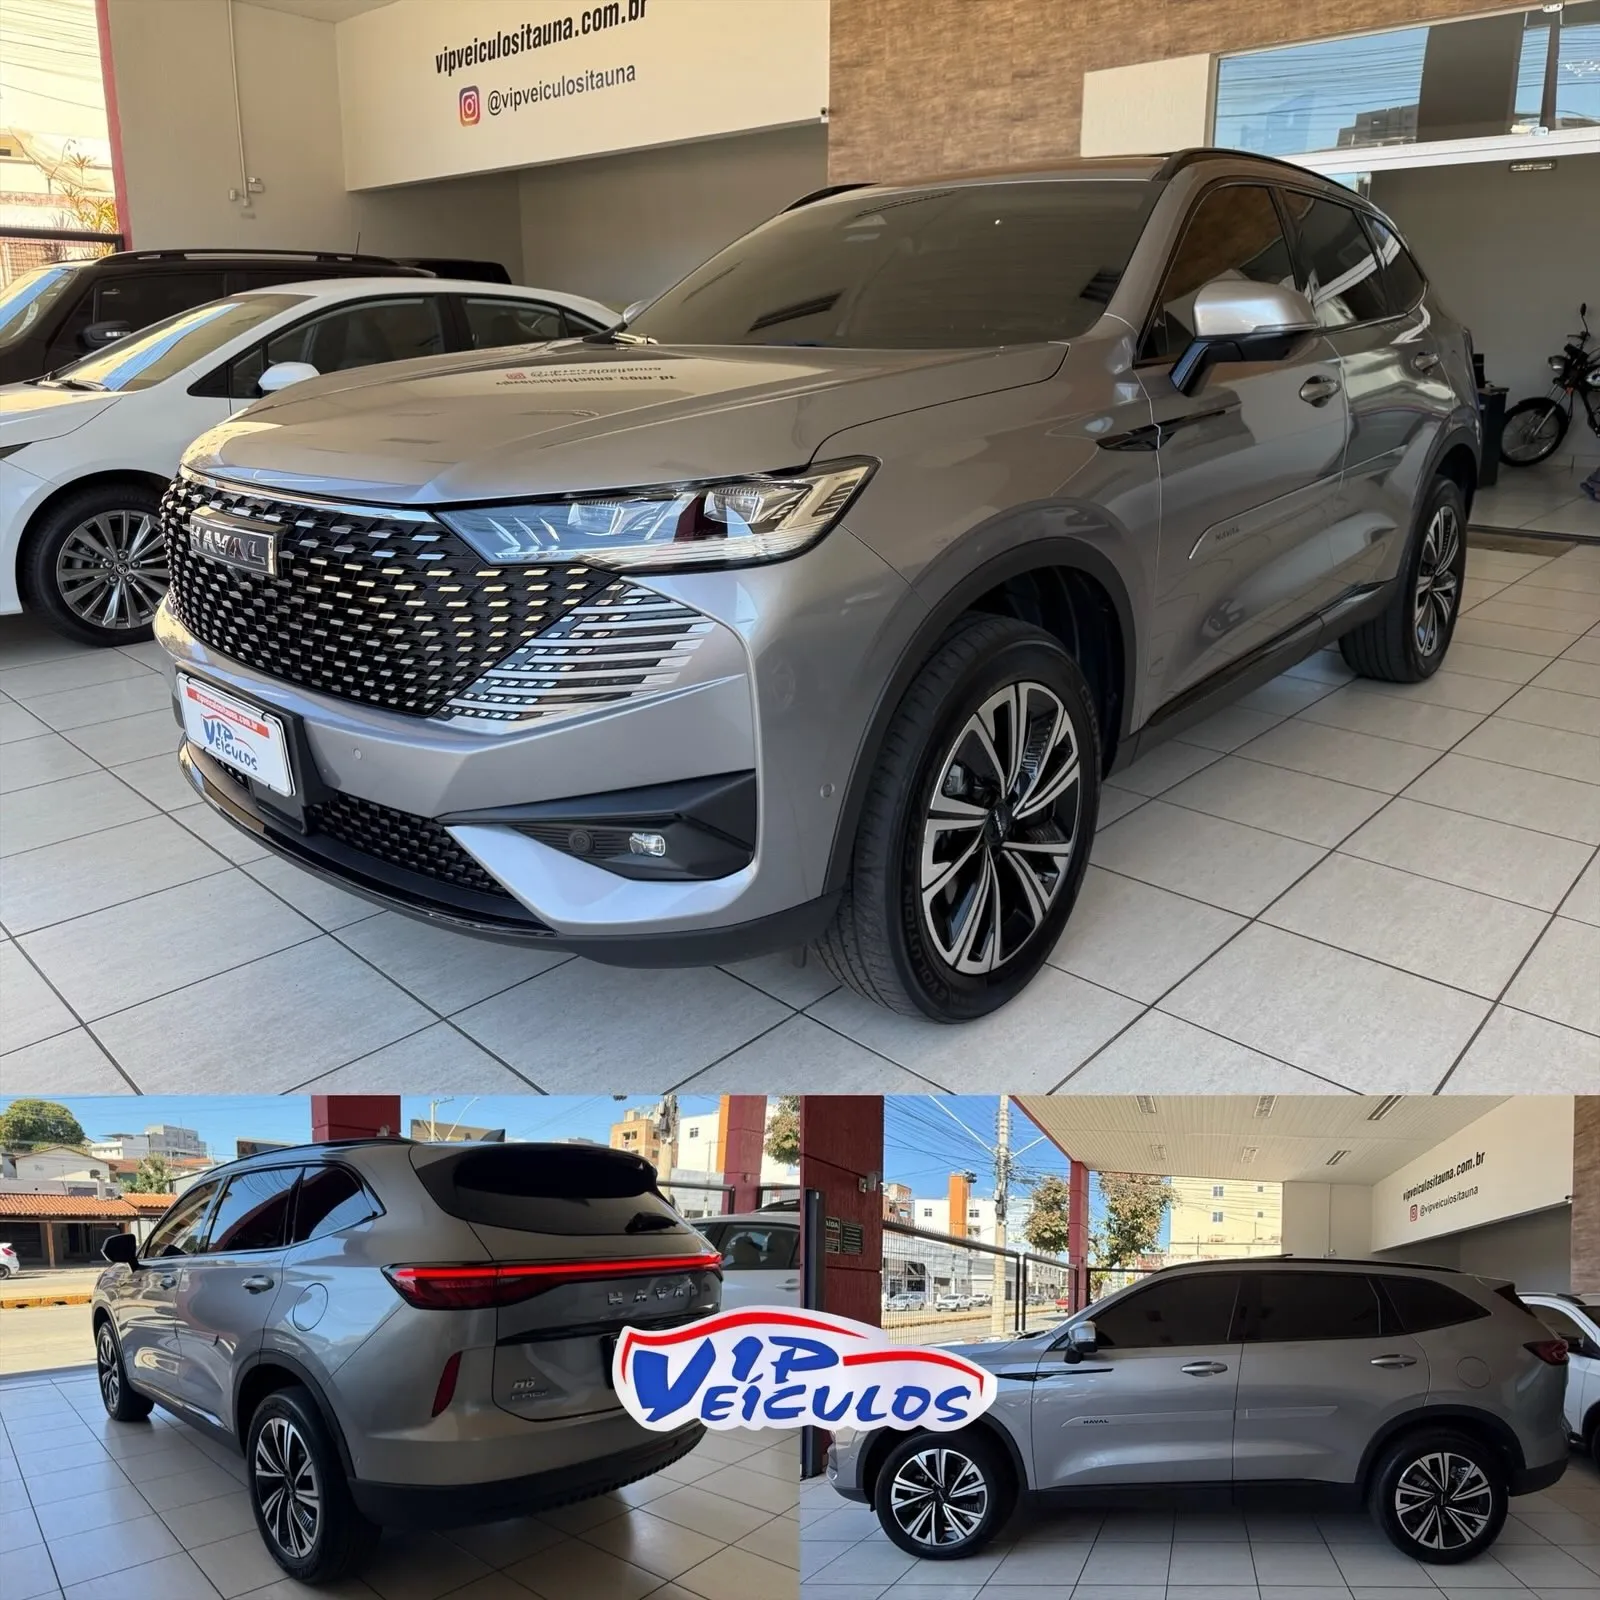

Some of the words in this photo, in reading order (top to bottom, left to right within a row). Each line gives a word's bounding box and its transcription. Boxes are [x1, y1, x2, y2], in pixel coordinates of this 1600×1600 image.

[435, 0, 648, 77] vipveiculositauna.com.br
[487, 64, 636, 116] @vipveiculositauna
[190, 524, 266, 566] HAVAL
[203, 718, 234, 745] VIP
[904, 885, 947, 1000] EVOLUTION
[1403, 1151, 1486, 1202] vipveiculositauna.com.br
[1419, 1185, 1479, 1217] @vipveiculositauna
